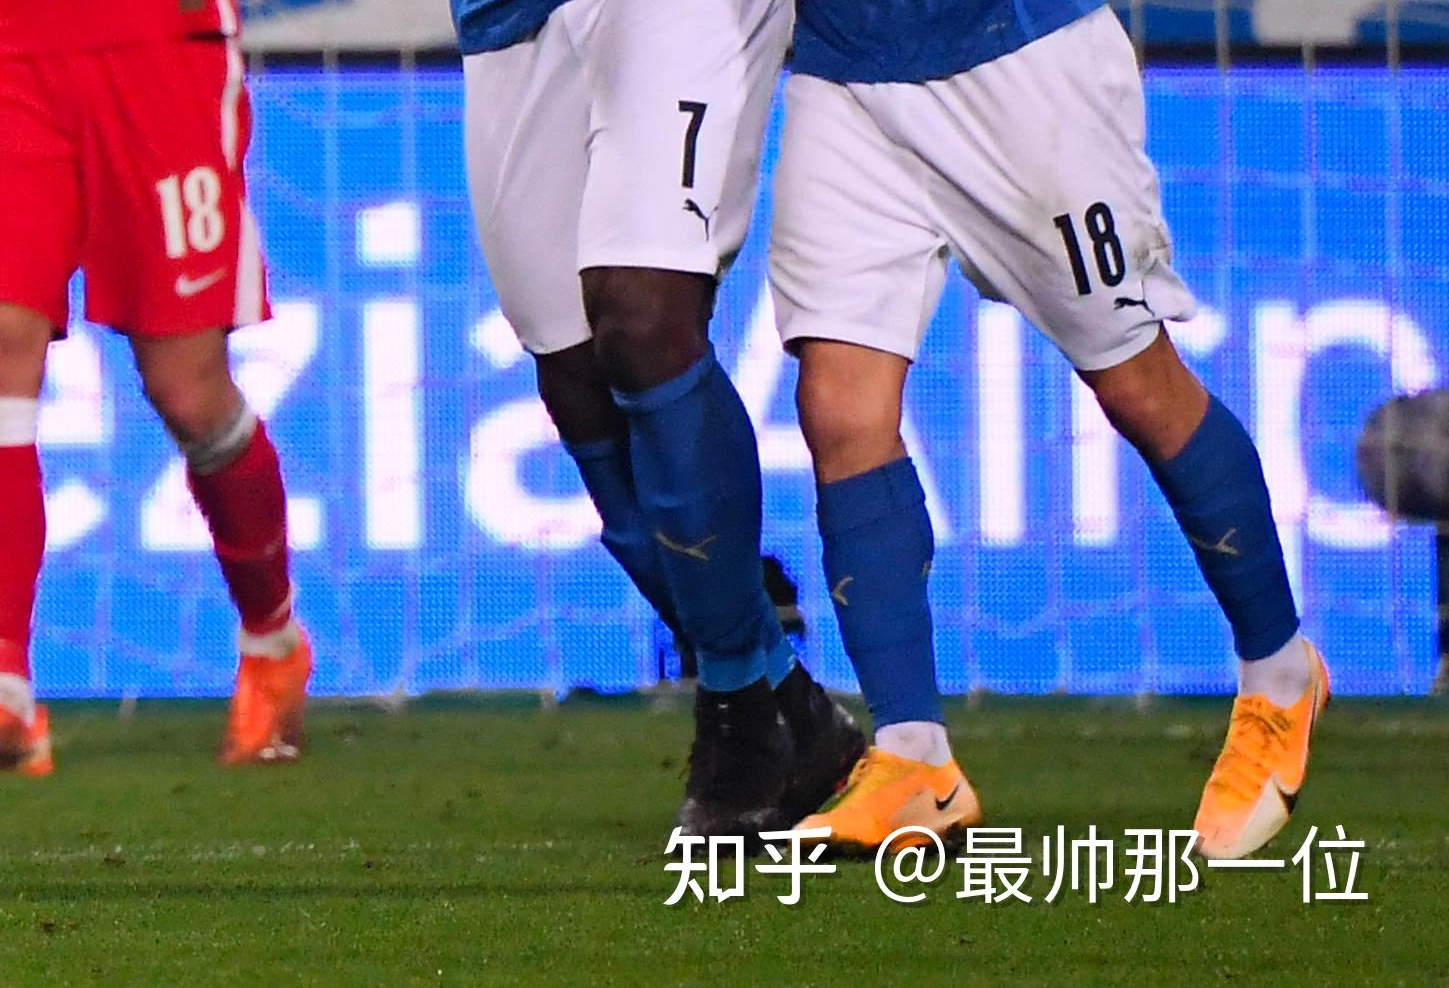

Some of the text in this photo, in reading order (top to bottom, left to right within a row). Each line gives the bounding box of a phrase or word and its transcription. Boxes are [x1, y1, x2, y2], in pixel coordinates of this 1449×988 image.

[677, 99, 708, 189] 7
[154, 165, 226, 260] 18
[1052, 201, 1127, 296] 18
